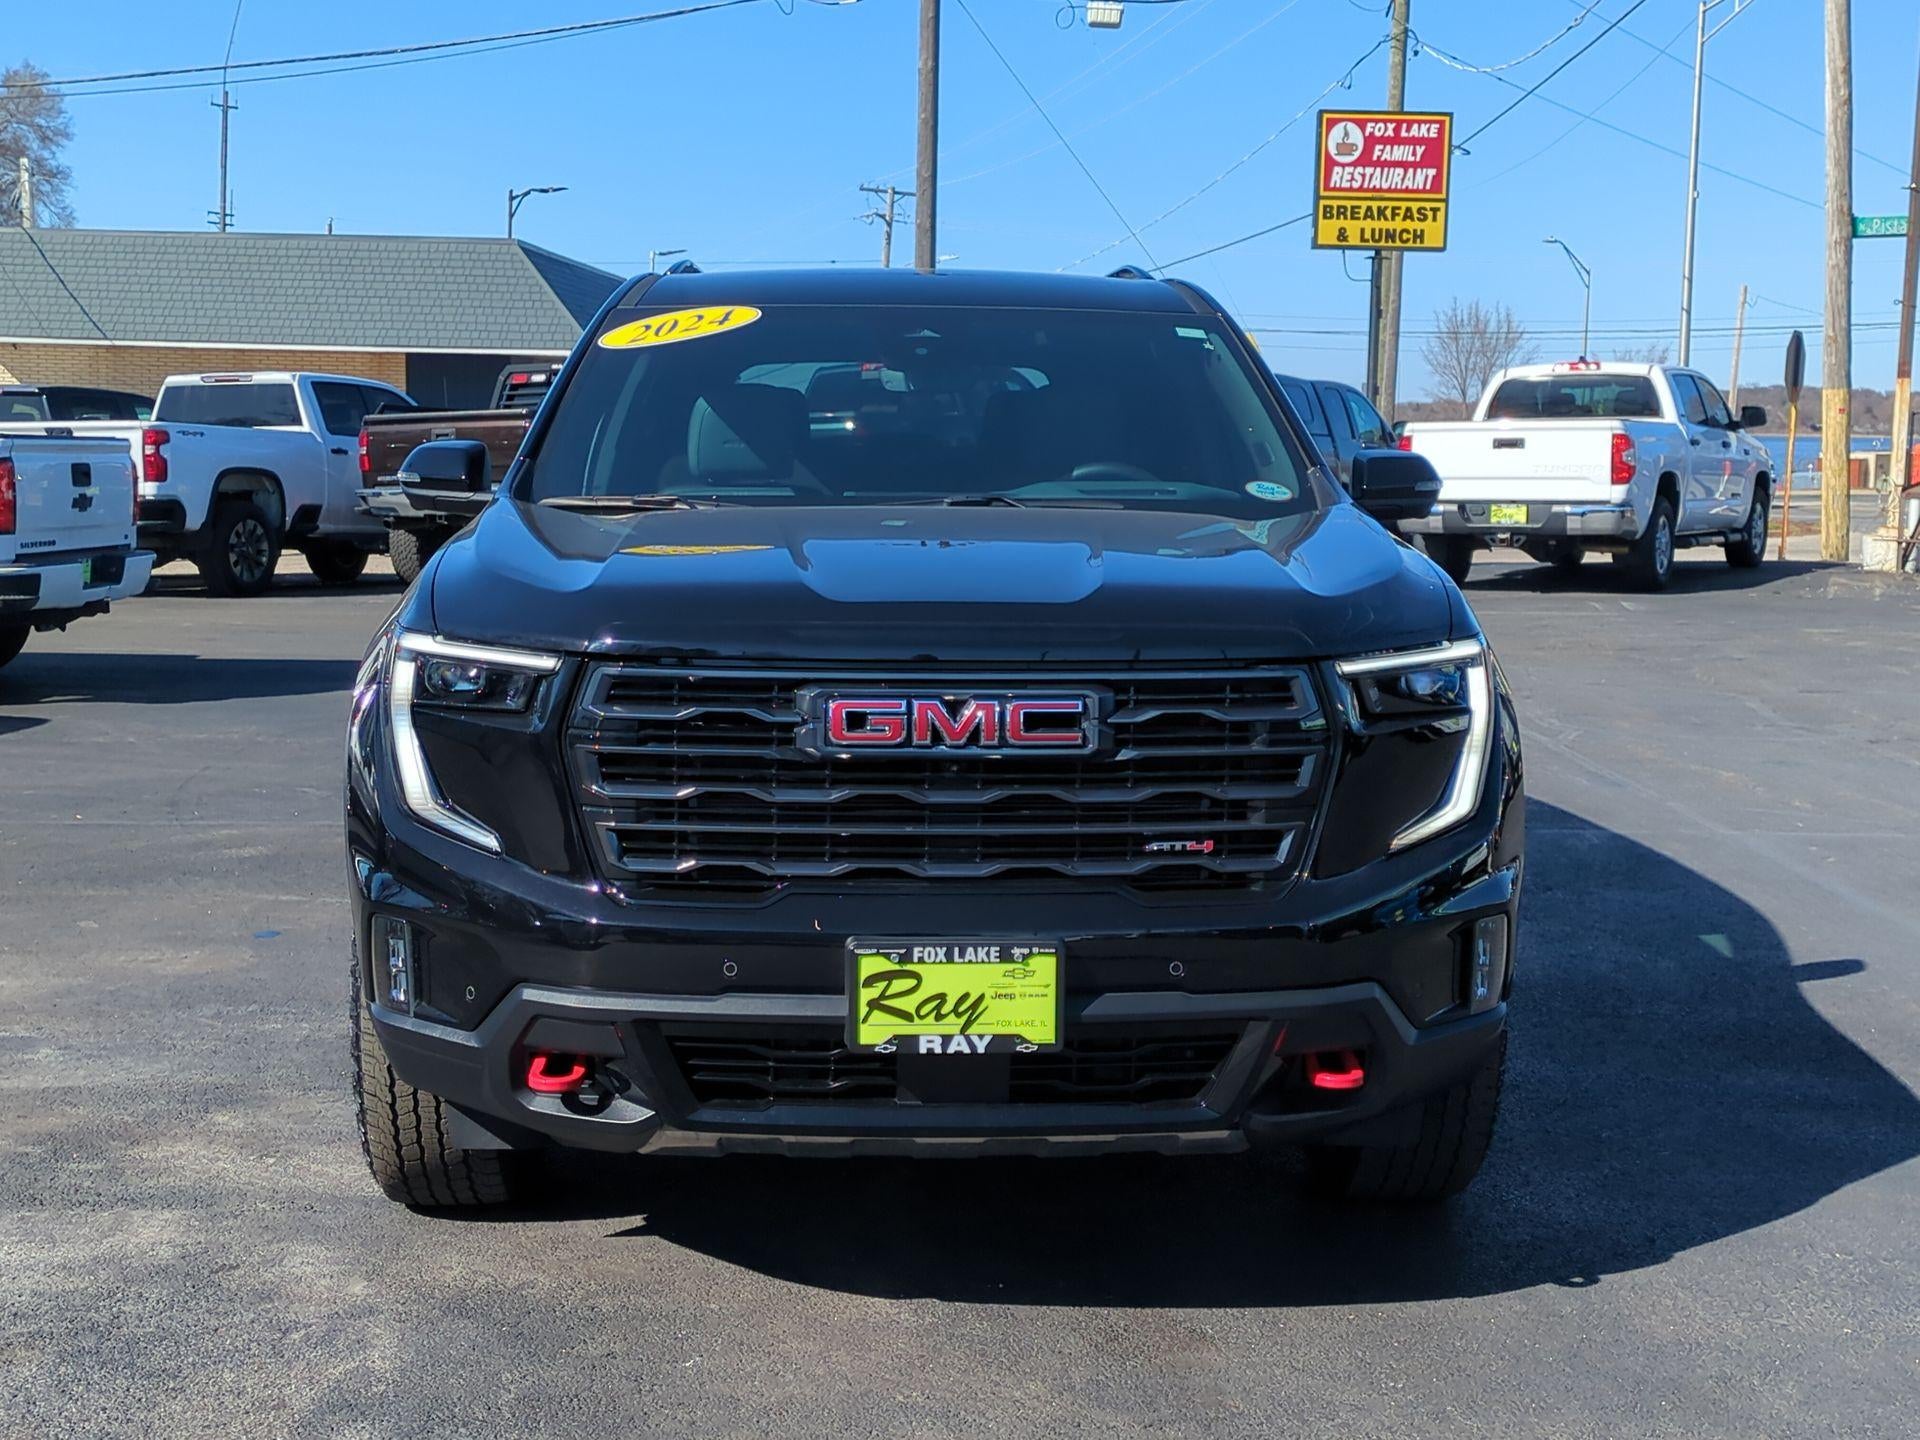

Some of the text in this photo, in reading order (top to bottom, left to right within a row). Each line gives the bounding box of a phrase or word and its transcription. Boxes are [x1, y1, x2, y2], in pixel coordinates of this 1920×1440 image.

[1365, 122, 1440, 138] FOX LAKE
[1372, 144, 1425, 162] FAMILY
[1329, 166, 1437, 190] RESTAURANT
[1322, 204, 1441, 222] BREAKFAST
[1336, 227, 1425, 244] & LUNCH
[626, 309, 736, 344] 2024
[828, 699, 1084, 746] GMC
[913, 947, 1000, 963] FOX LAKE
[861, 969, 988, 1035] Ray
[991, 991, 1016, 1000] Jeep
[919, 1035, 993, 1054] RAY
